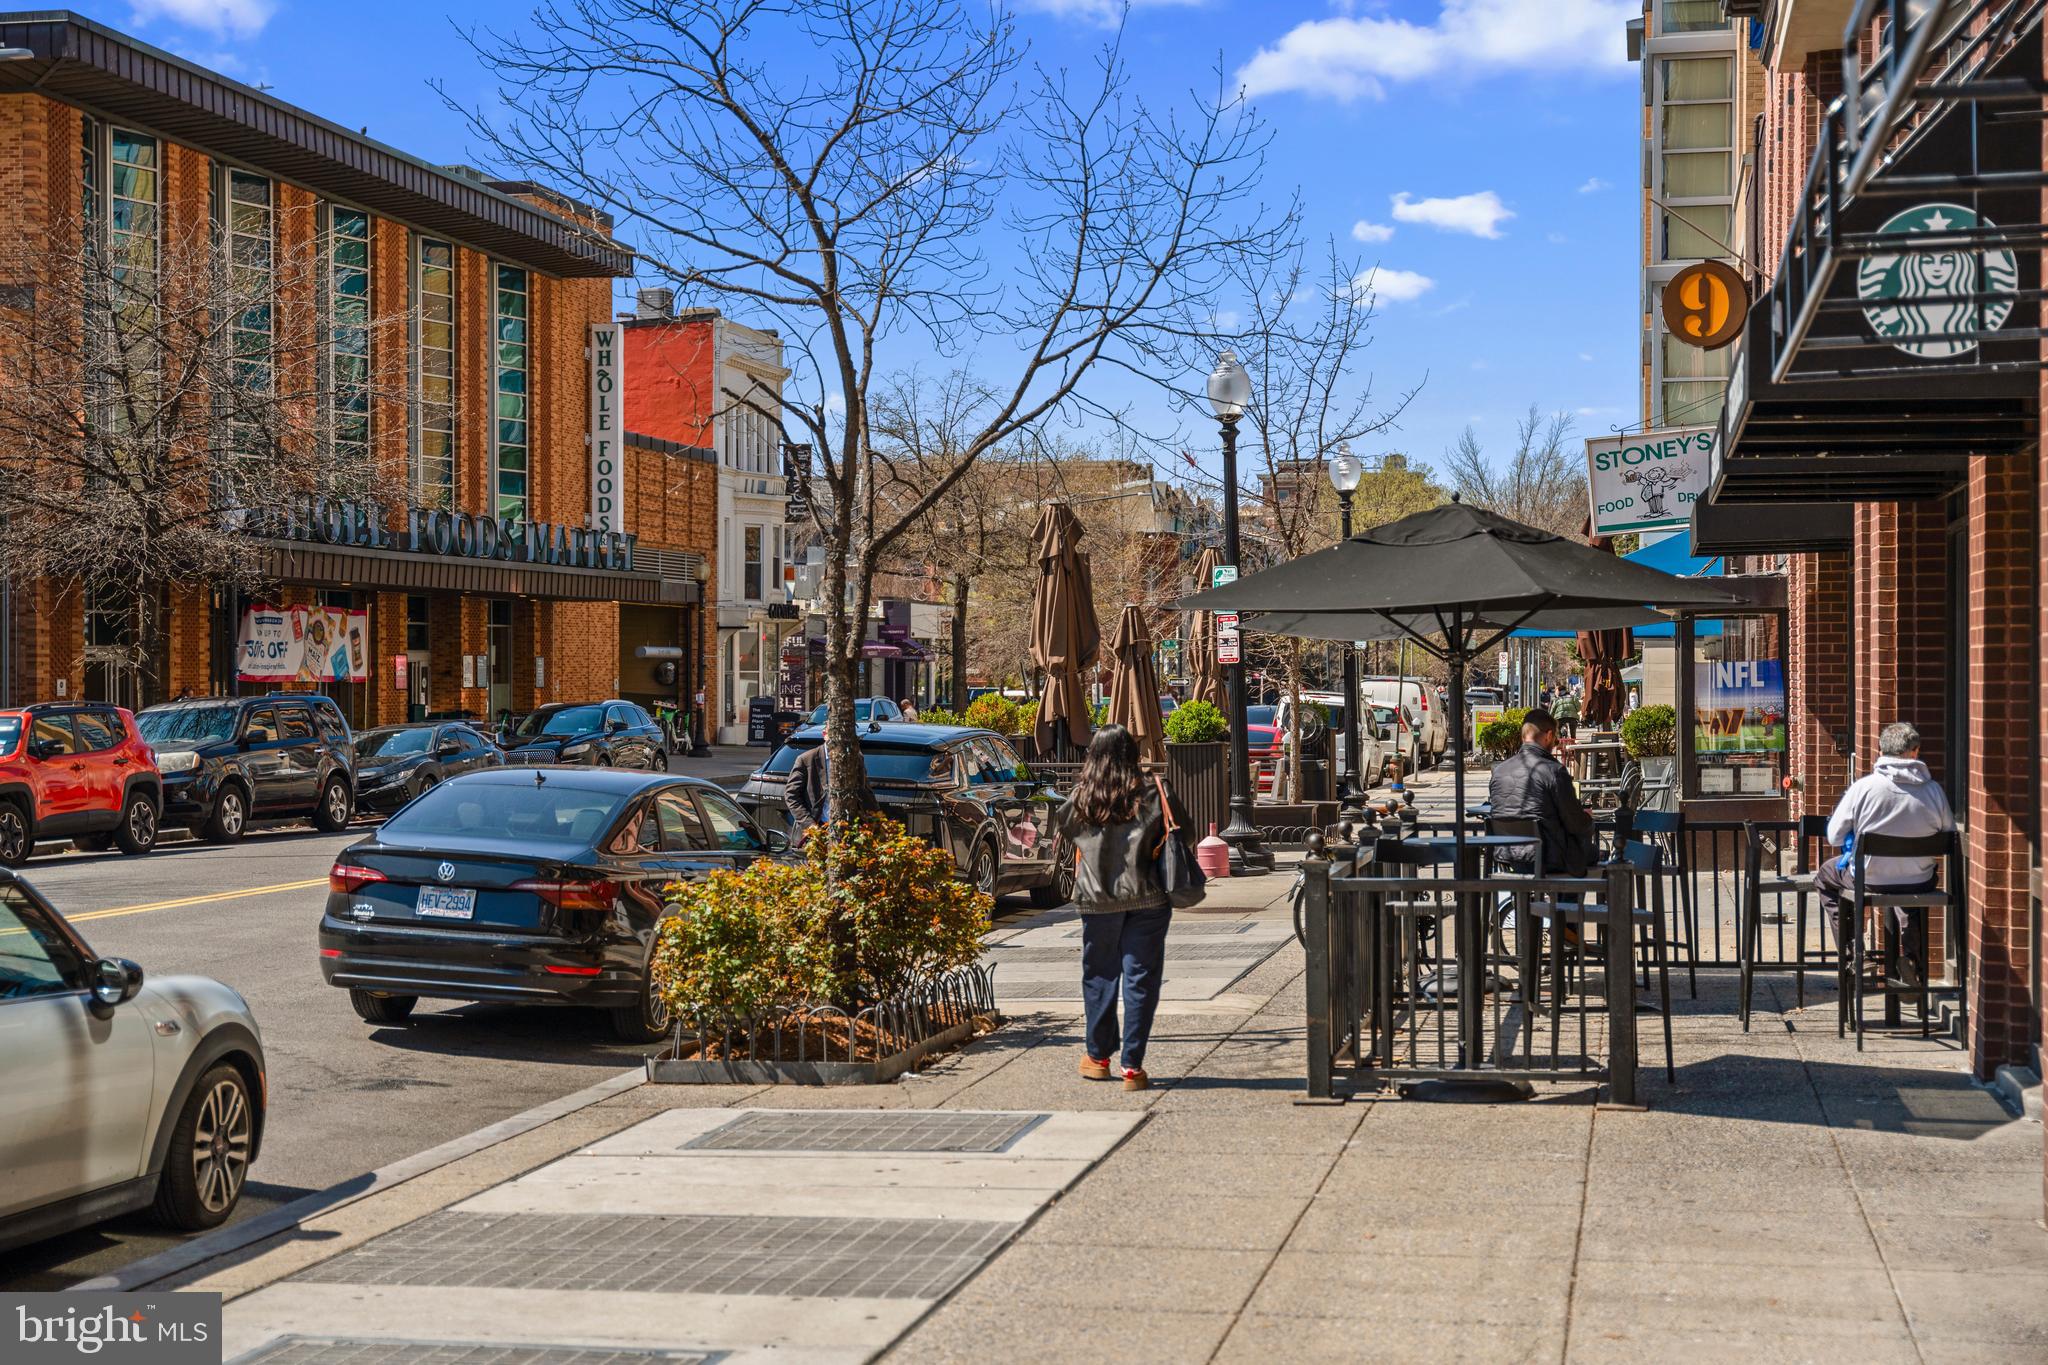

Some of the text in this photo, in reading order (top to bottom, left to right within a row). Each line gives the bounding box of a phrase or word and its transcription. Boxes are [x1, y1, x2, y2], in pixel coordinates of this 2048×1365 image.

[1680, 272, 1730, 338] 9
[595, 331, 614, 431] WHOLE
[1595, 432, 1713, 471] STONEY'S
[597, 440, 613, 534] FOODS
[1598, 497, 1634, 515] FOOD
[408, 508, 515, 561] FOODS
[525, 521, 638, 573] MARKET
[1716, 661, 1764, 688] NFL
[421, 892, 472, 911] HEV-2994
